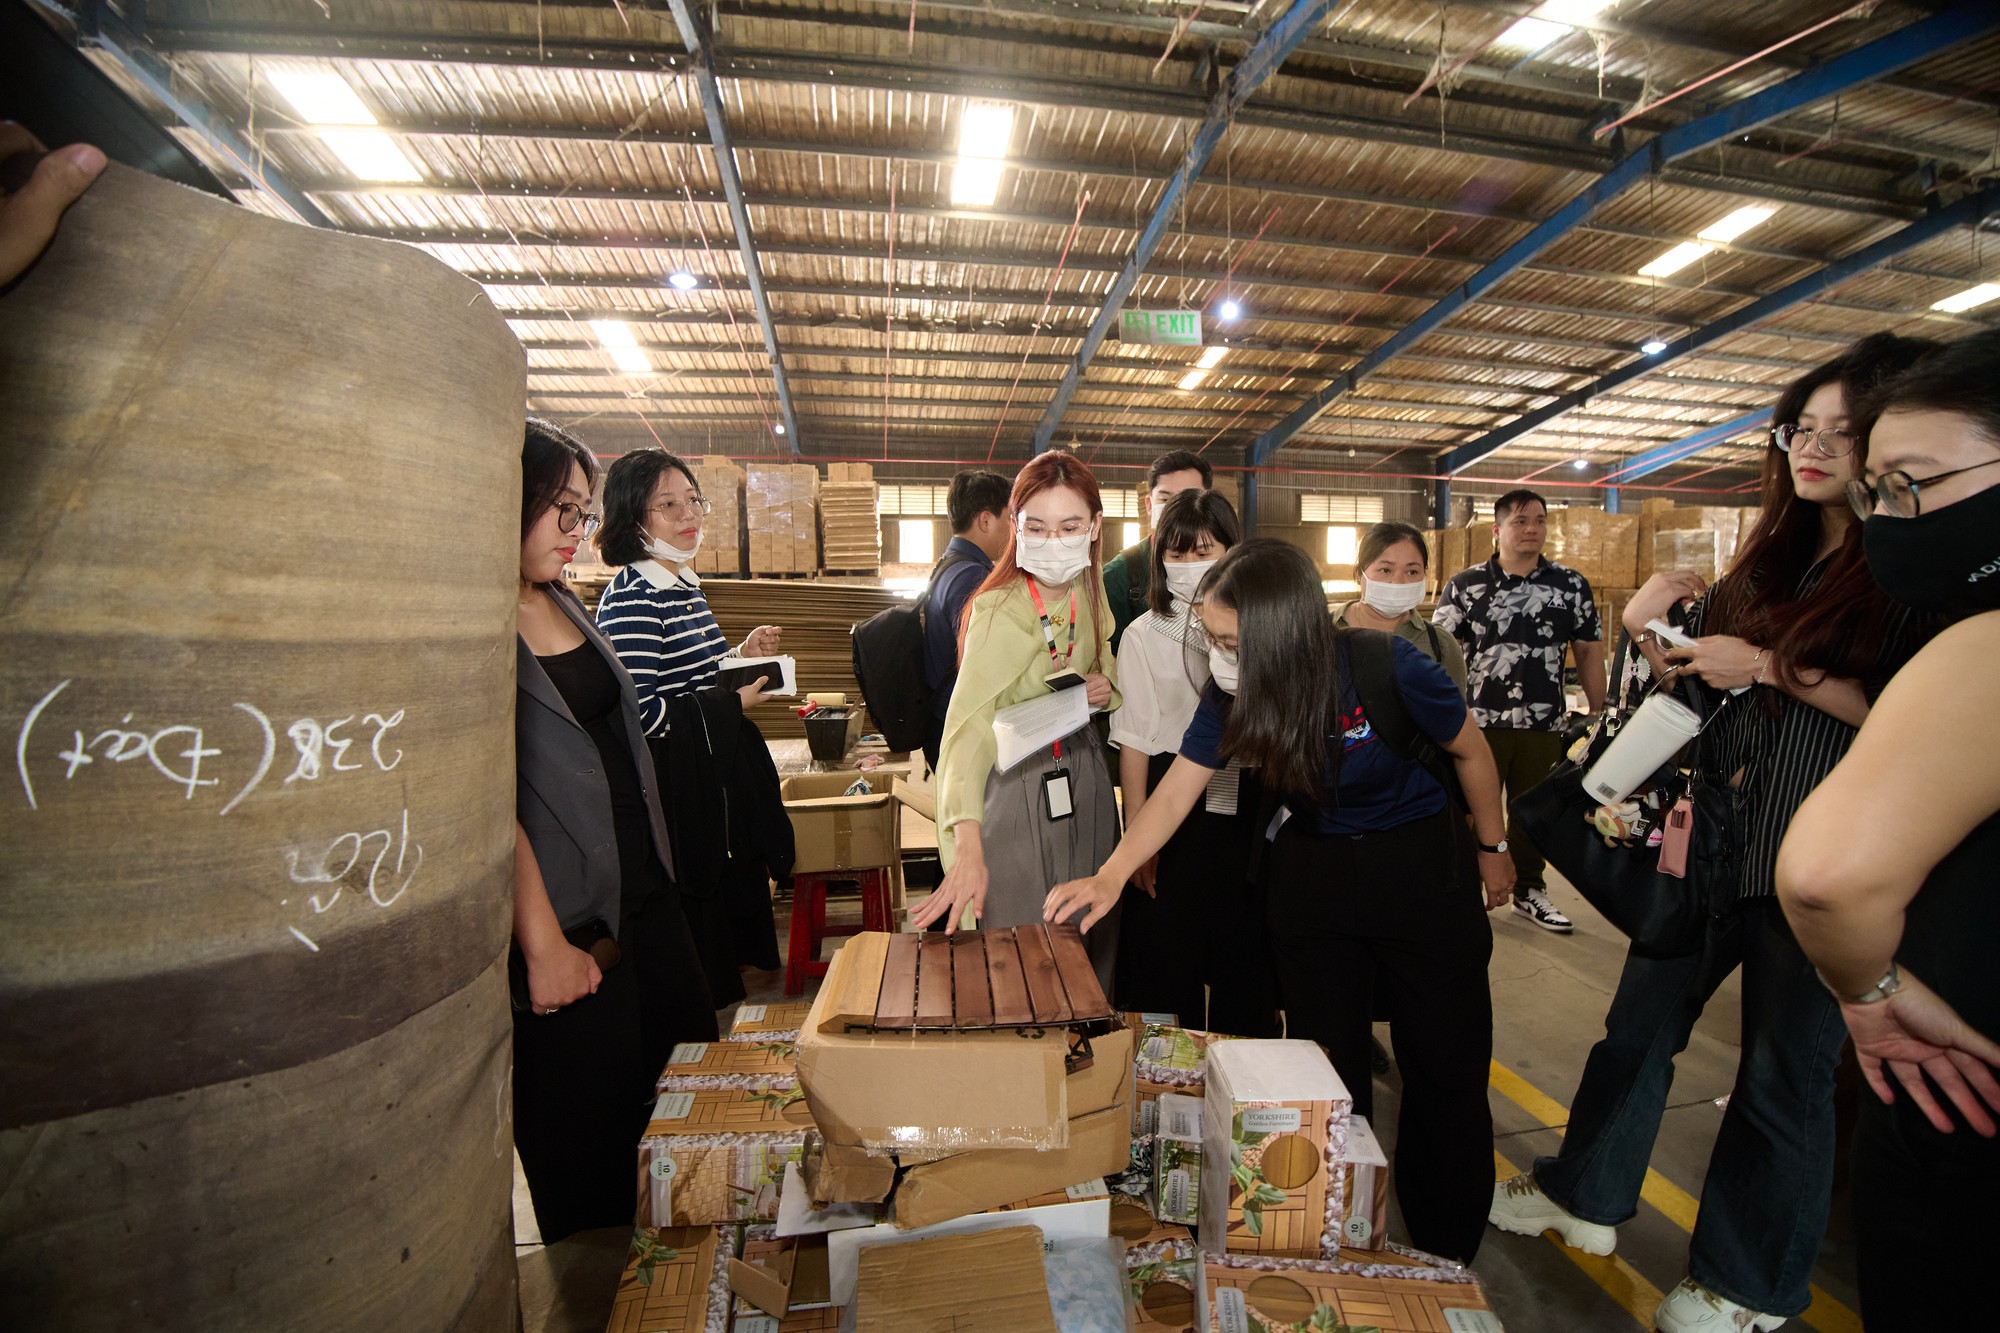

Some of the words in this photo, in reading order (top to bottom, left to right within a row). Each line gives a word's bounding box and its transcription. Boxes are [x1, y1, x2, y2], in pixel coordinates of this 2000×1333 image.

[1156, 314, 1195, 334] EXIT
[1248, 1113, 1296, 1121] YORKSHIRE
[662, 1164, 671, 1173] 10
[1170, 1174, 1179, 1213] YORKSHIRE
[1350, 1224, 1359, 1234] 10
